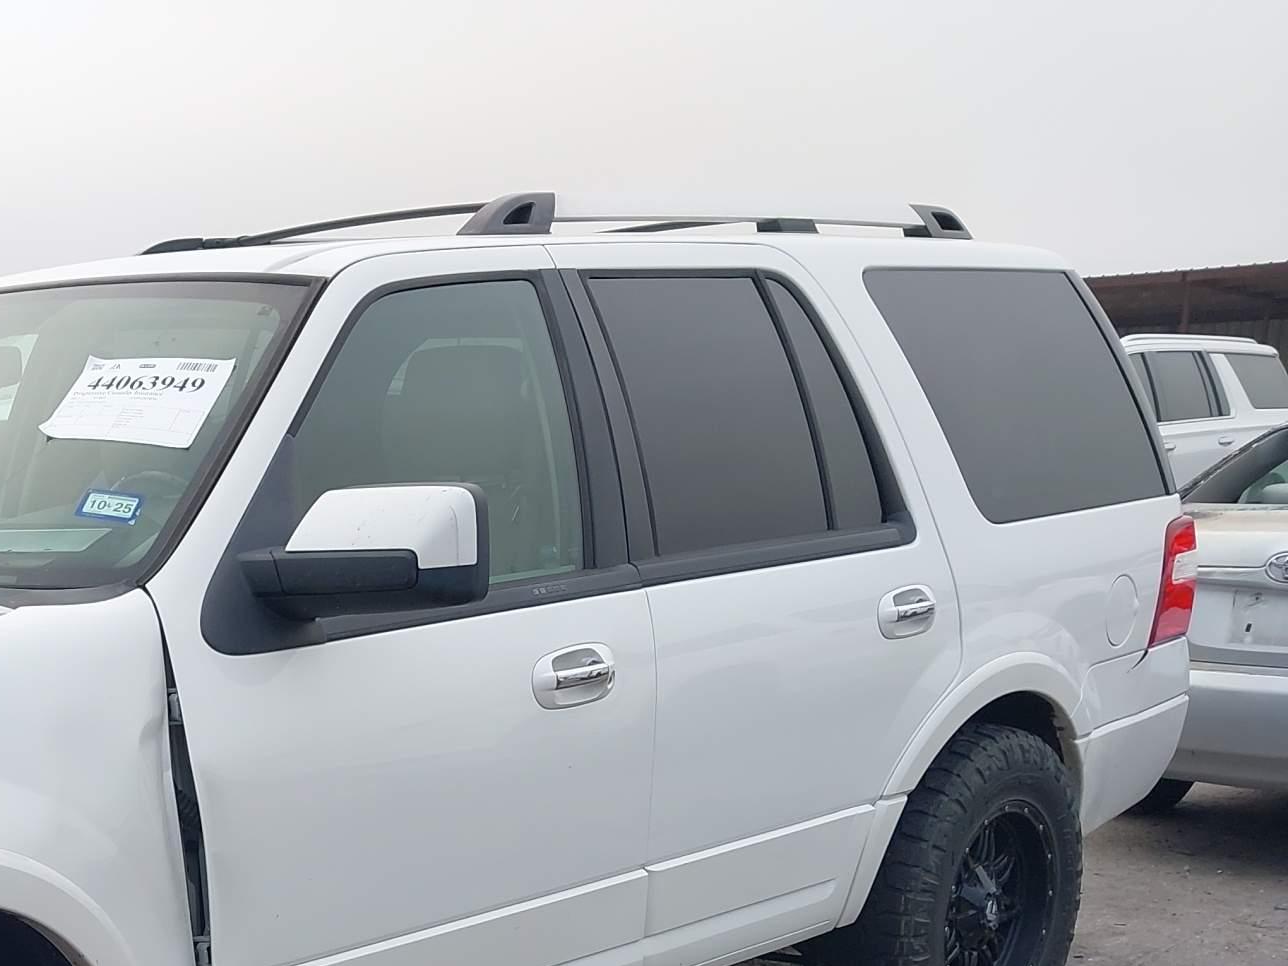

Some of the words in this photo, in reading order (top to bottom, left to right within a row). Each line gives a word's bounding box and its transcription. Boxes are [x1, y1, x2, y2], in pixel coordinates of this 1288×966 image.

[87, 375, 206, 393] 44063949
[90, 499, 107, 511] 10
[112, 502, 134, 514] 25
